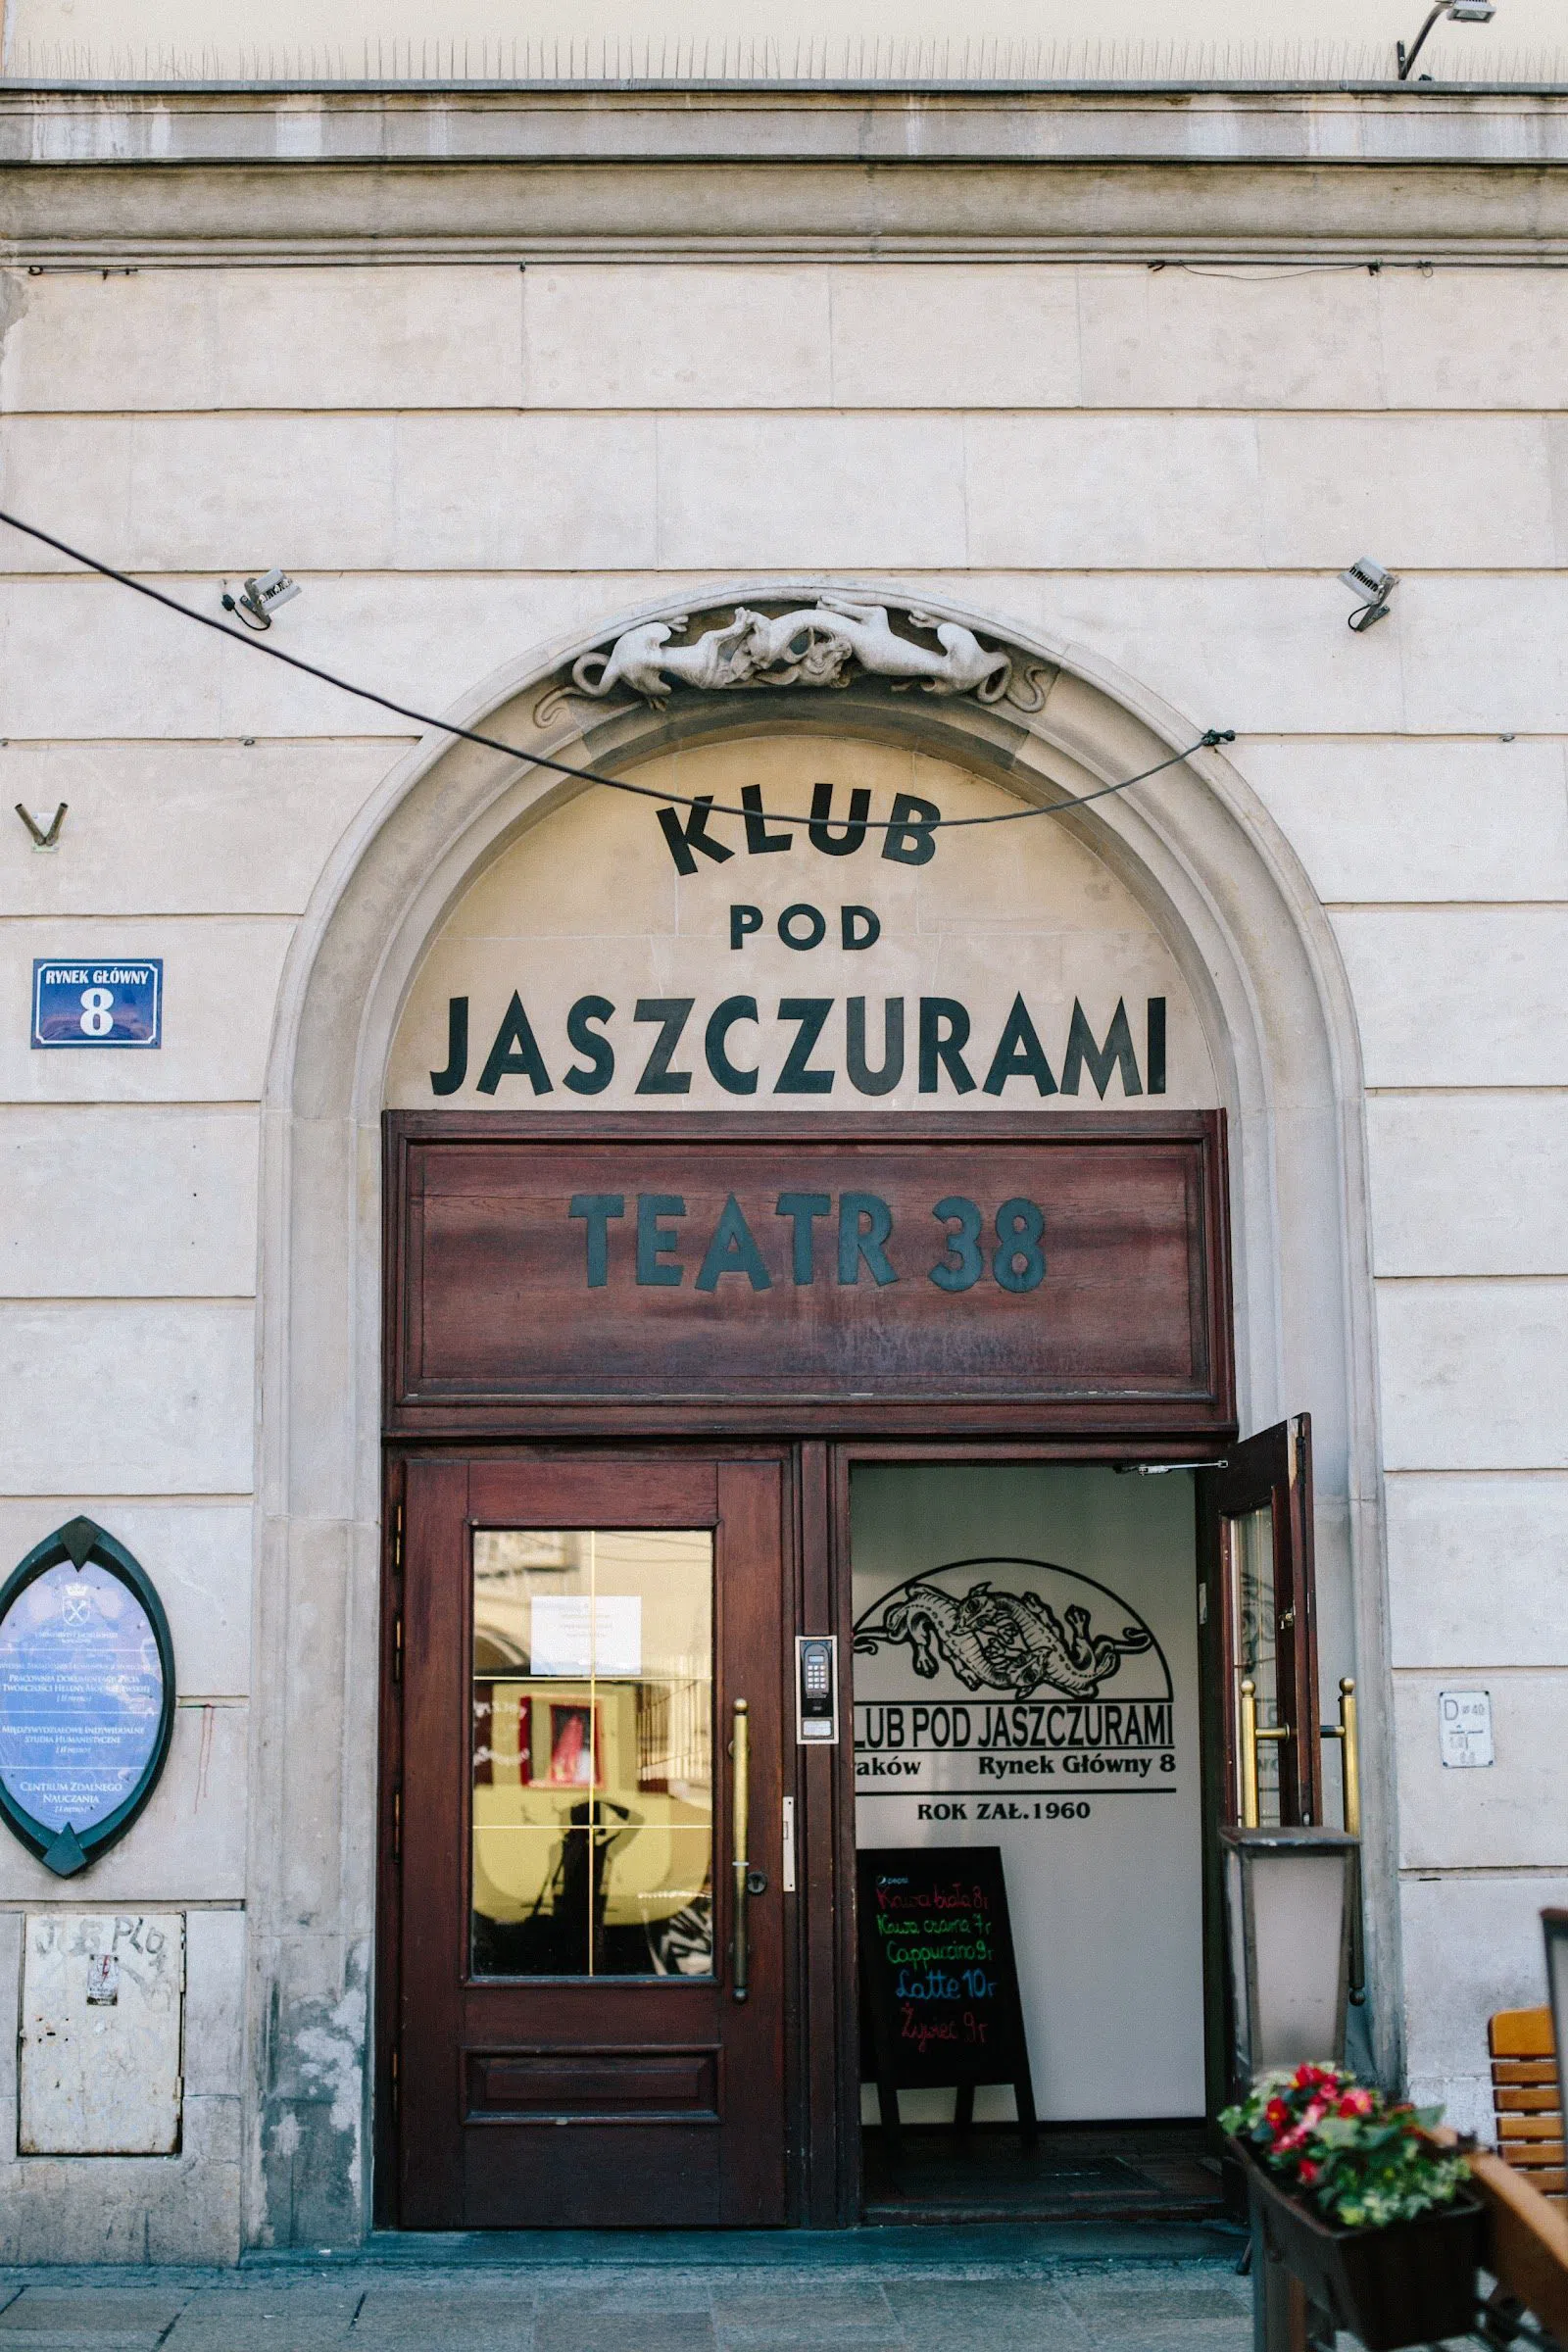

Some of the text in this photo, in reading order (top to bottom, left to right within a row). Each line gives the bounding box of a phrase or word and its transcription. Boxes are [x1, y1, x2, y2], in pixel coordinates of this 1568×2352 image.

[656, 783, 941, 876] KLUB
[729, 904, 881, 951] POD
[46, 967, 149, 984] RYNEK GŁÓWNY
[80, 988, 114, 1036] 8
[429, 989, 1166, 1101] JASZCZURAMI
[568, 1192, 1048, 1293] TEATR 38
[912, 1707, 970, 1747] POD
[977, 1704, 1173, 1747] JASZCZURAMI
[855, 1753, 1176, 1779] aków Rynek Główny 8
[20, 1782, 122, 1792] CENTRUM ZDALNEGO
[43, 1794, 100, 1803] NAUCZANIA
[917, 1803, 968, 1821] ROK
[875, 1886, 931, 1910] Kawa
[933, 1881, 972, 1910] biała
[876, 1912, 920, 1936] Kawa
[923, 1918, 970, 1936] czarna
[886, 1939, 976, 1971] Cappuccino
[895, 1968, 961, 2000] Latte
